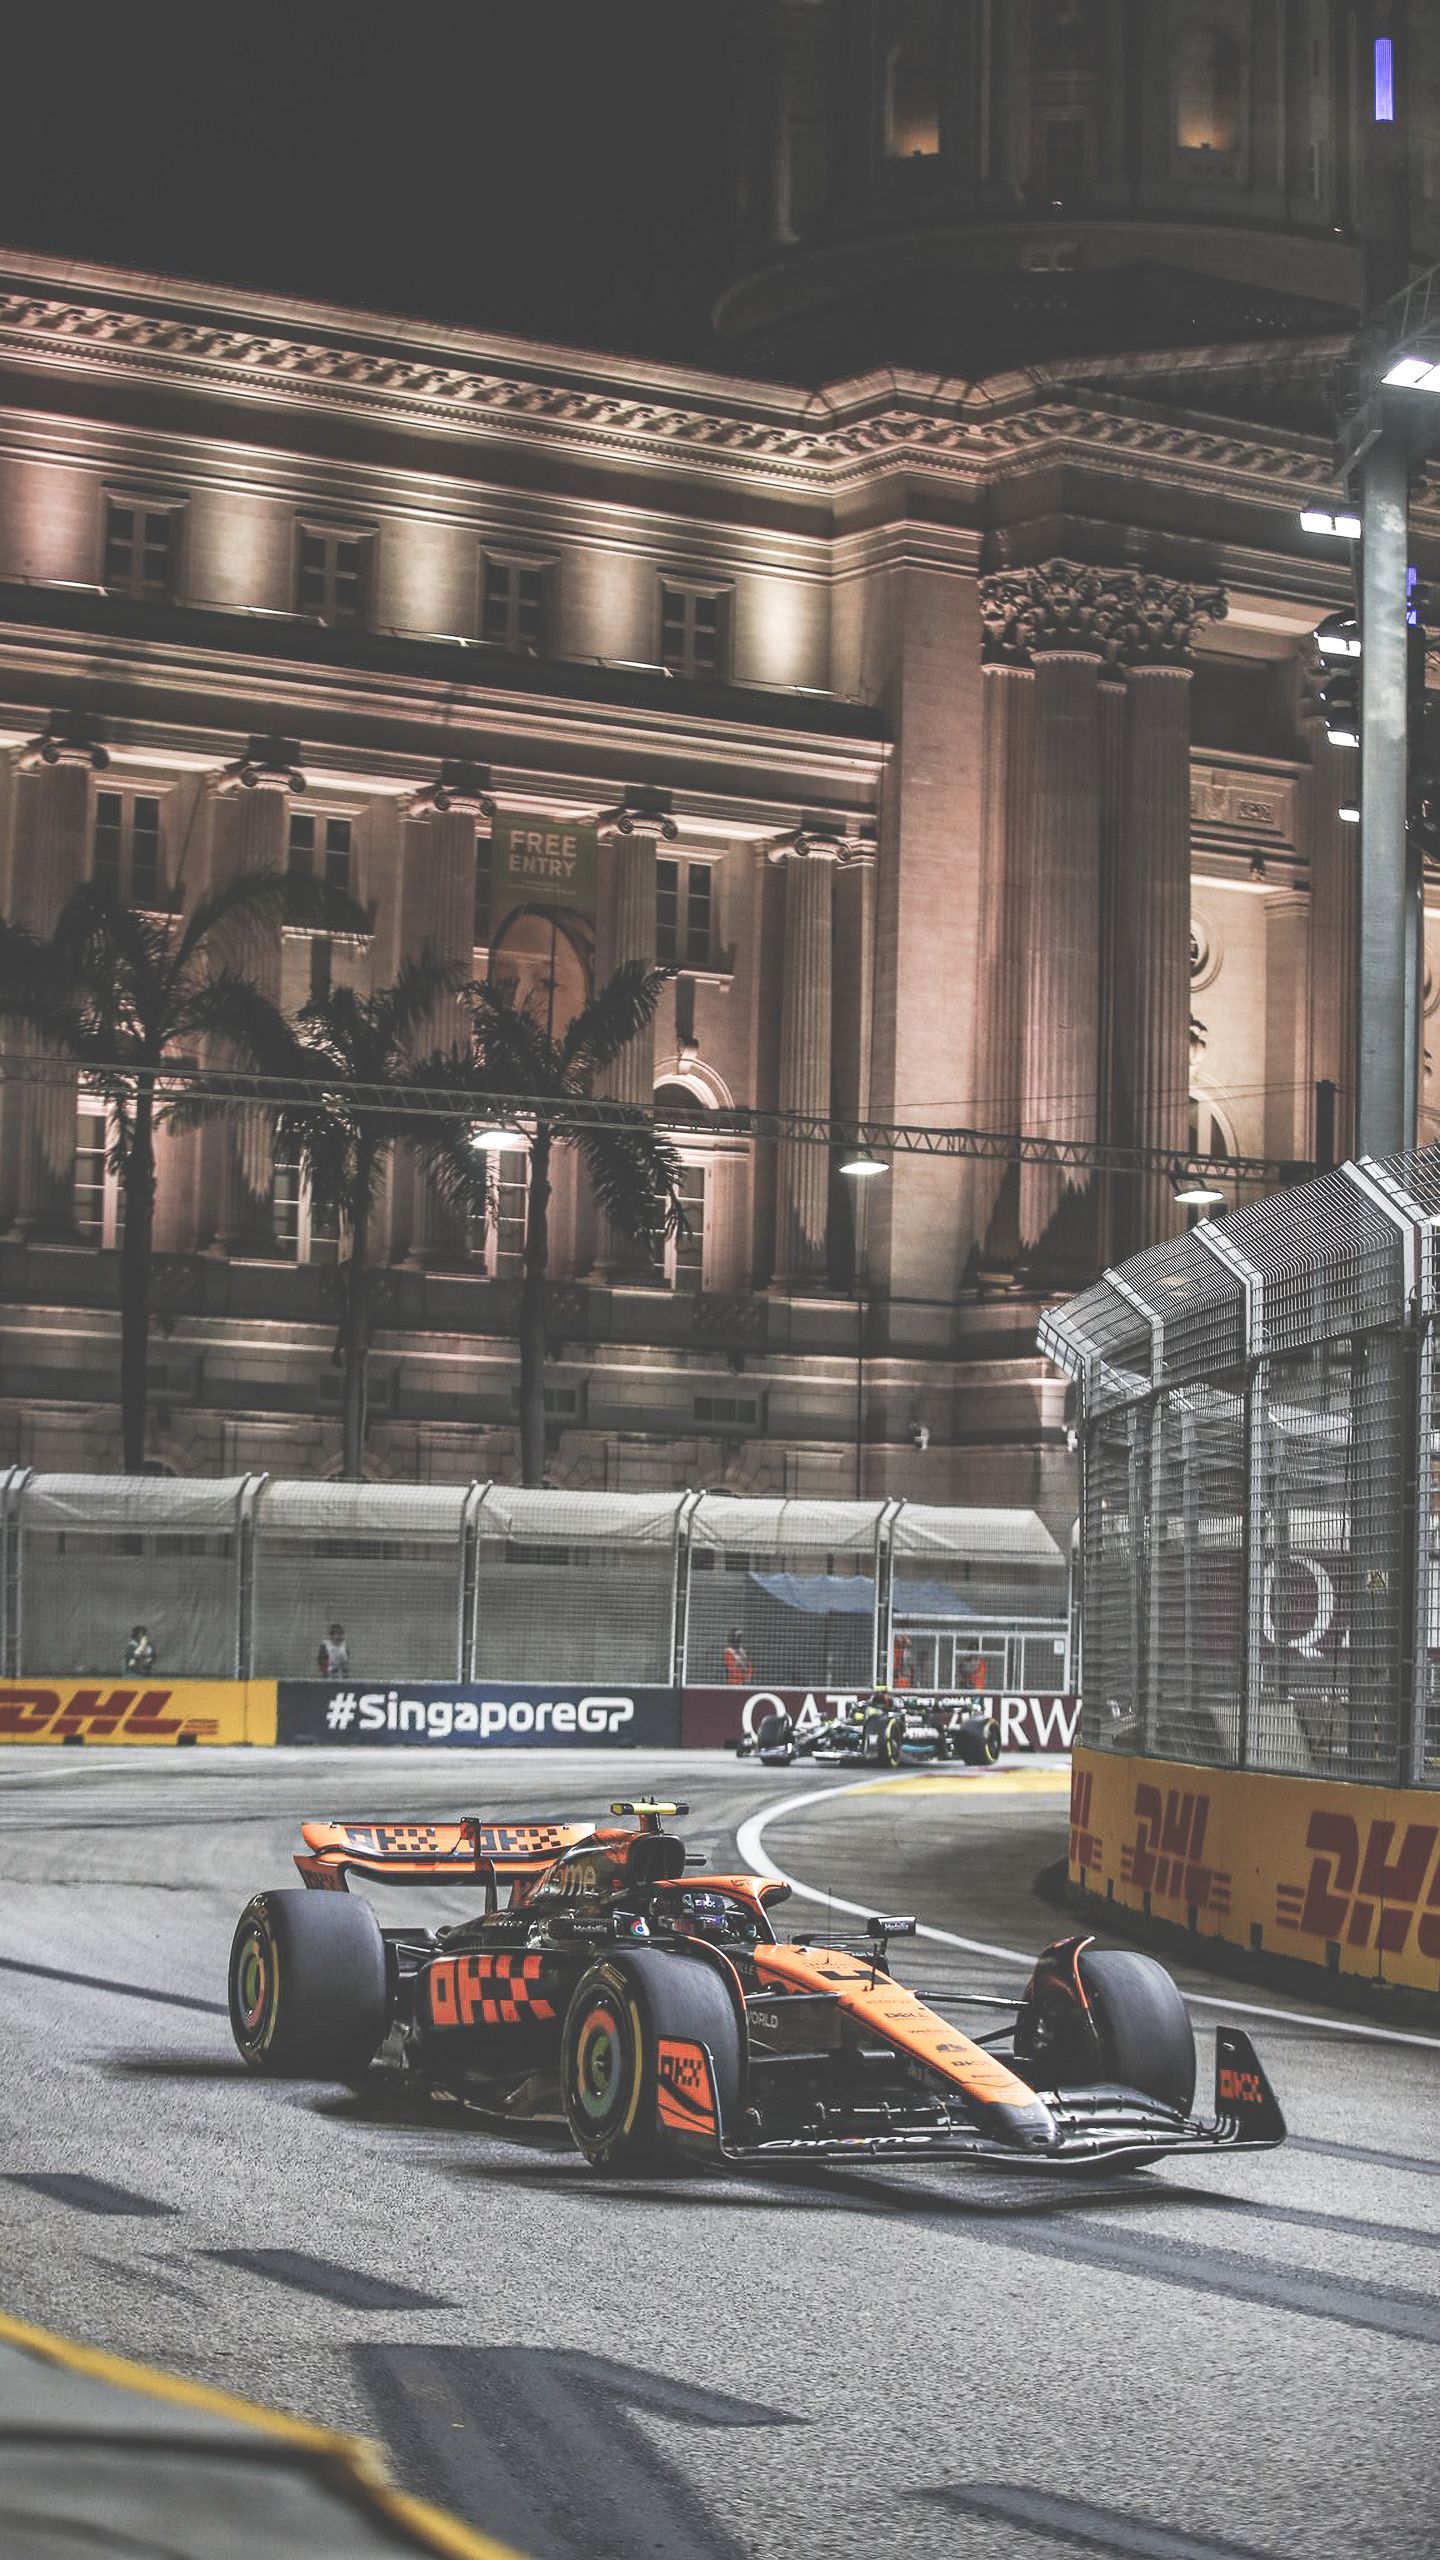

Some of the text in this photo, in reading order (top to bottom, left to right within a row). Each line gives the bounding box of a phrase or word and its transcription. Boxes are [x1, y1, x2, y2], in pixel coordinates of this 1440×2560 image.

[508, 854, 576, 877] ENTRY
[510, 829, 577, 858] FREE
[0, 1689, 184, 1735] DHL
[326, 1691, 634, 1738] #SingaporeGP
[1131, 1782, 1212, 1908] DHL
[430, 1955, 556, 2025] OKX
